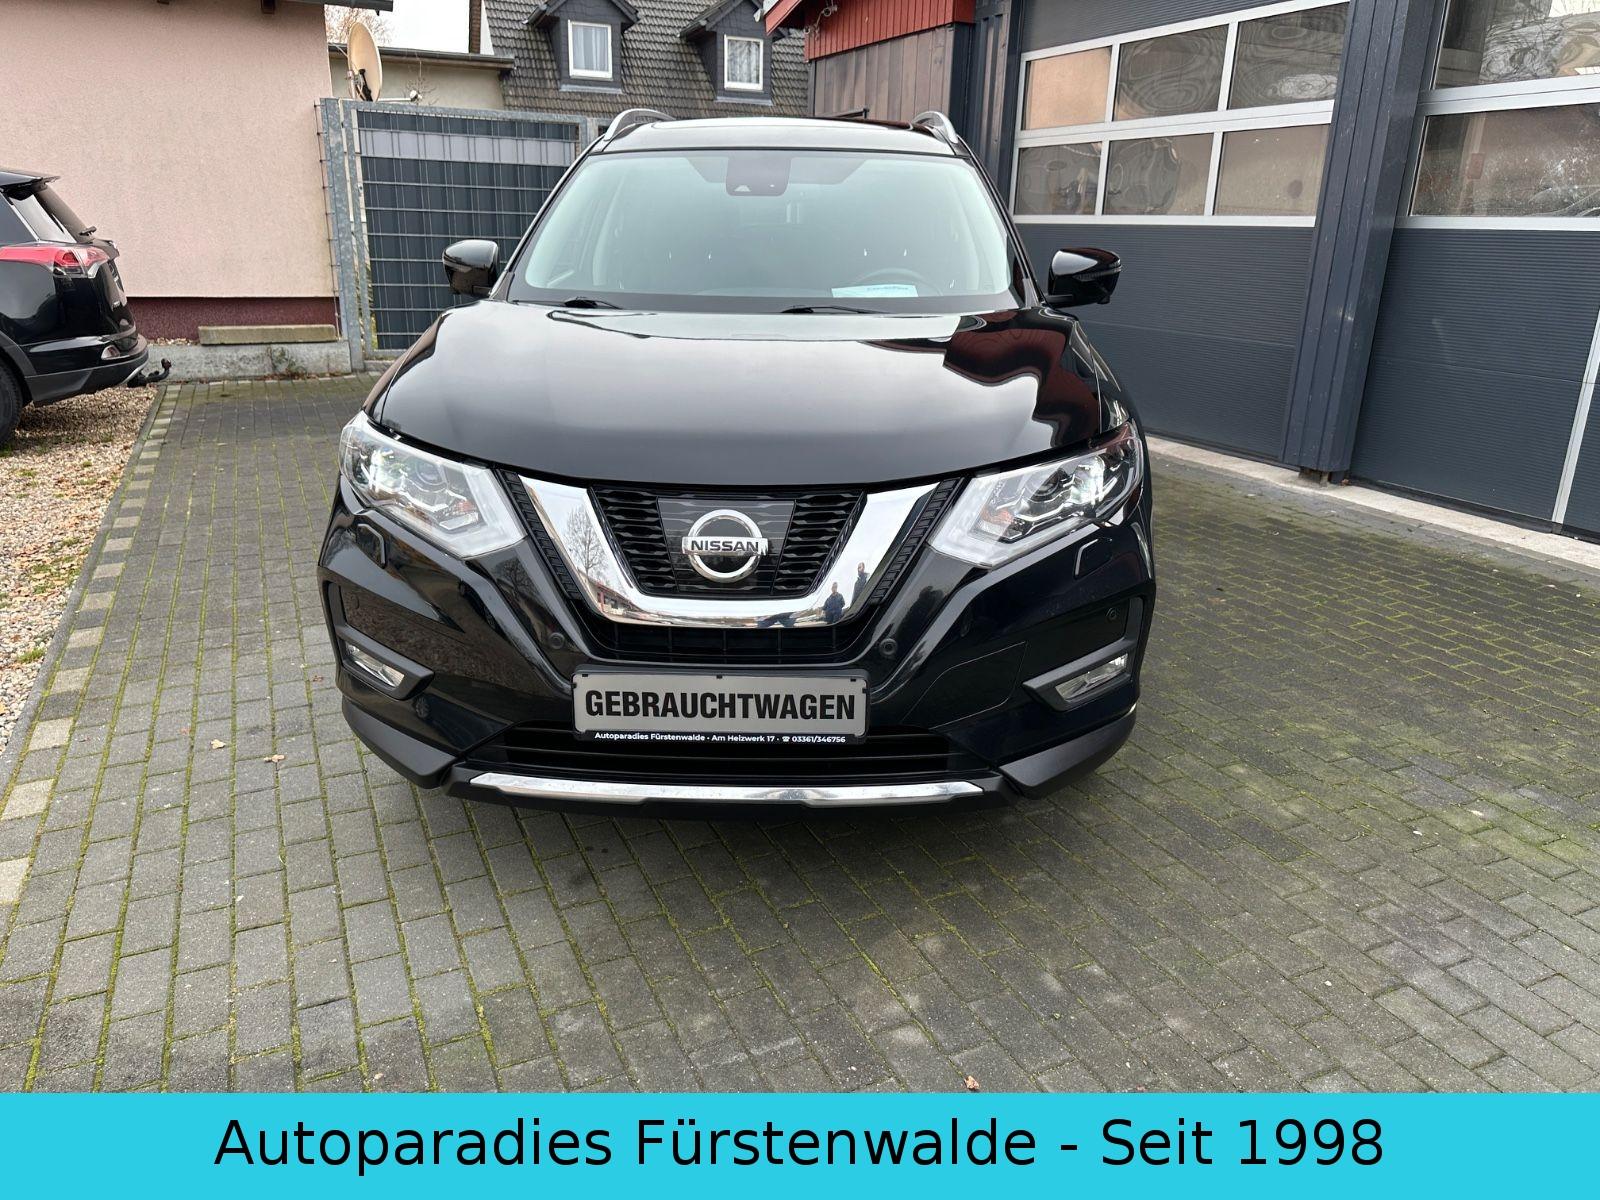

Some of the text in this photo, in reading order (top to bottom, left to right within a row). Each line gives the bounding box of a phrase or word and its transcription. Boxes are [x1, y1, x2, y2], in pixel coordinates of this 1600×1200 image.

[690, 540, 759, 552] NISSAN
[585, 690, 855, 720] GEBRAUCHTWAGEN
[594, 732, 649, 741] Autoparadies
[650, 733, 706, 741] Fürstenwalde
[711, 734, 726, 742] Am
[727, 734, 766, 742] Heizwerk
[791, 735, 847, 743] 03361/346756
